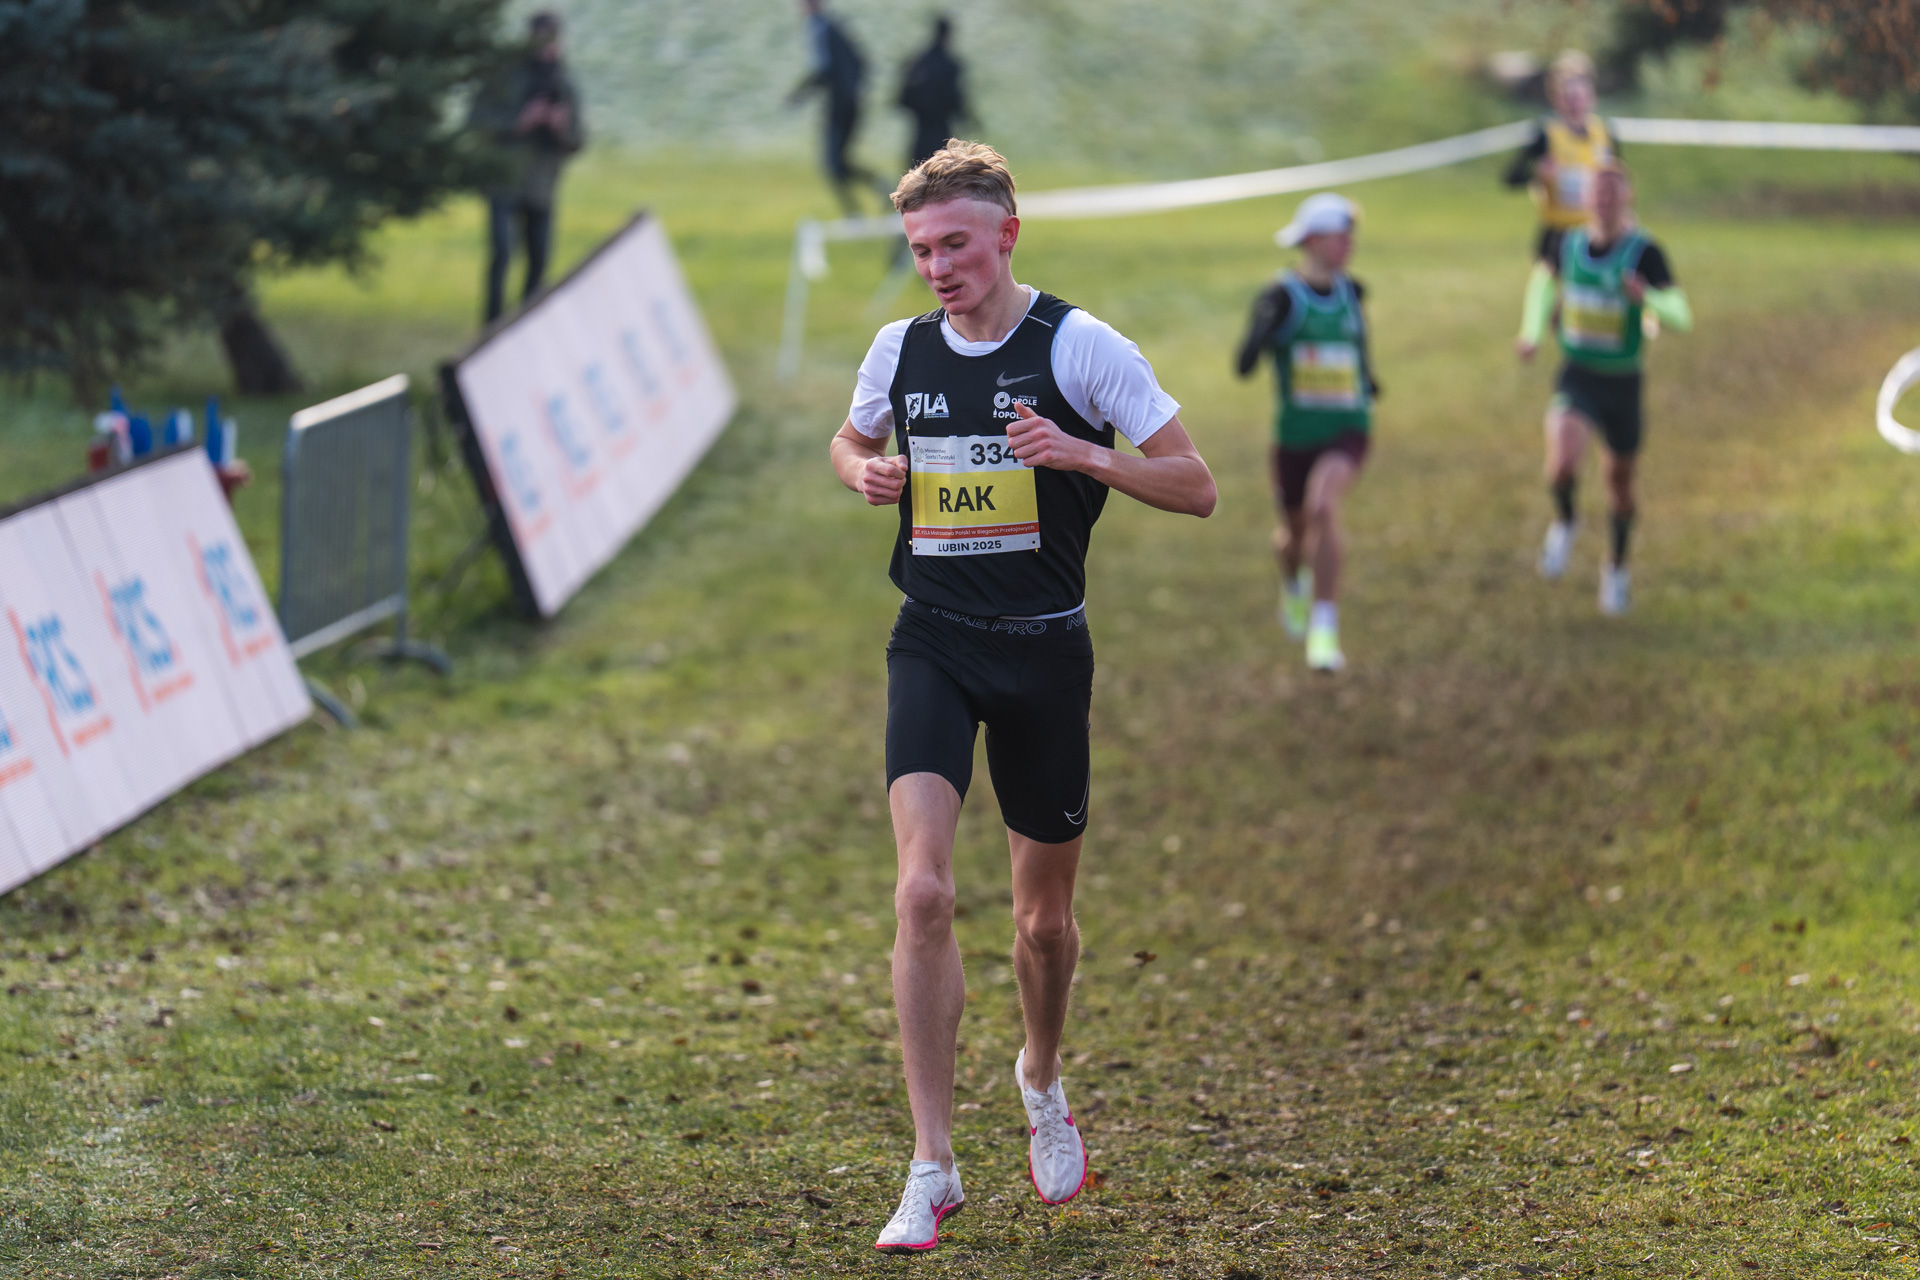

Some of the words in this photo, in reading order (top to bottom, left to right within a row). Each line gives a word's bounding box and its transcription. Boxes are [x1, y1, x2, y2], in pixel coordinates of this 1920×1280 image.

[1011, 397, 1038, 406] OPOLE
[998, 411, 1024, 419] OPOL
[970, 443, 1019, 465] 334
[938, 485, 997, 513] RAK
[938, 542, 970, 552] LUBIN
[972, 540, 1002, 550] 2025
[991, 620, 1047, 635] PRO
